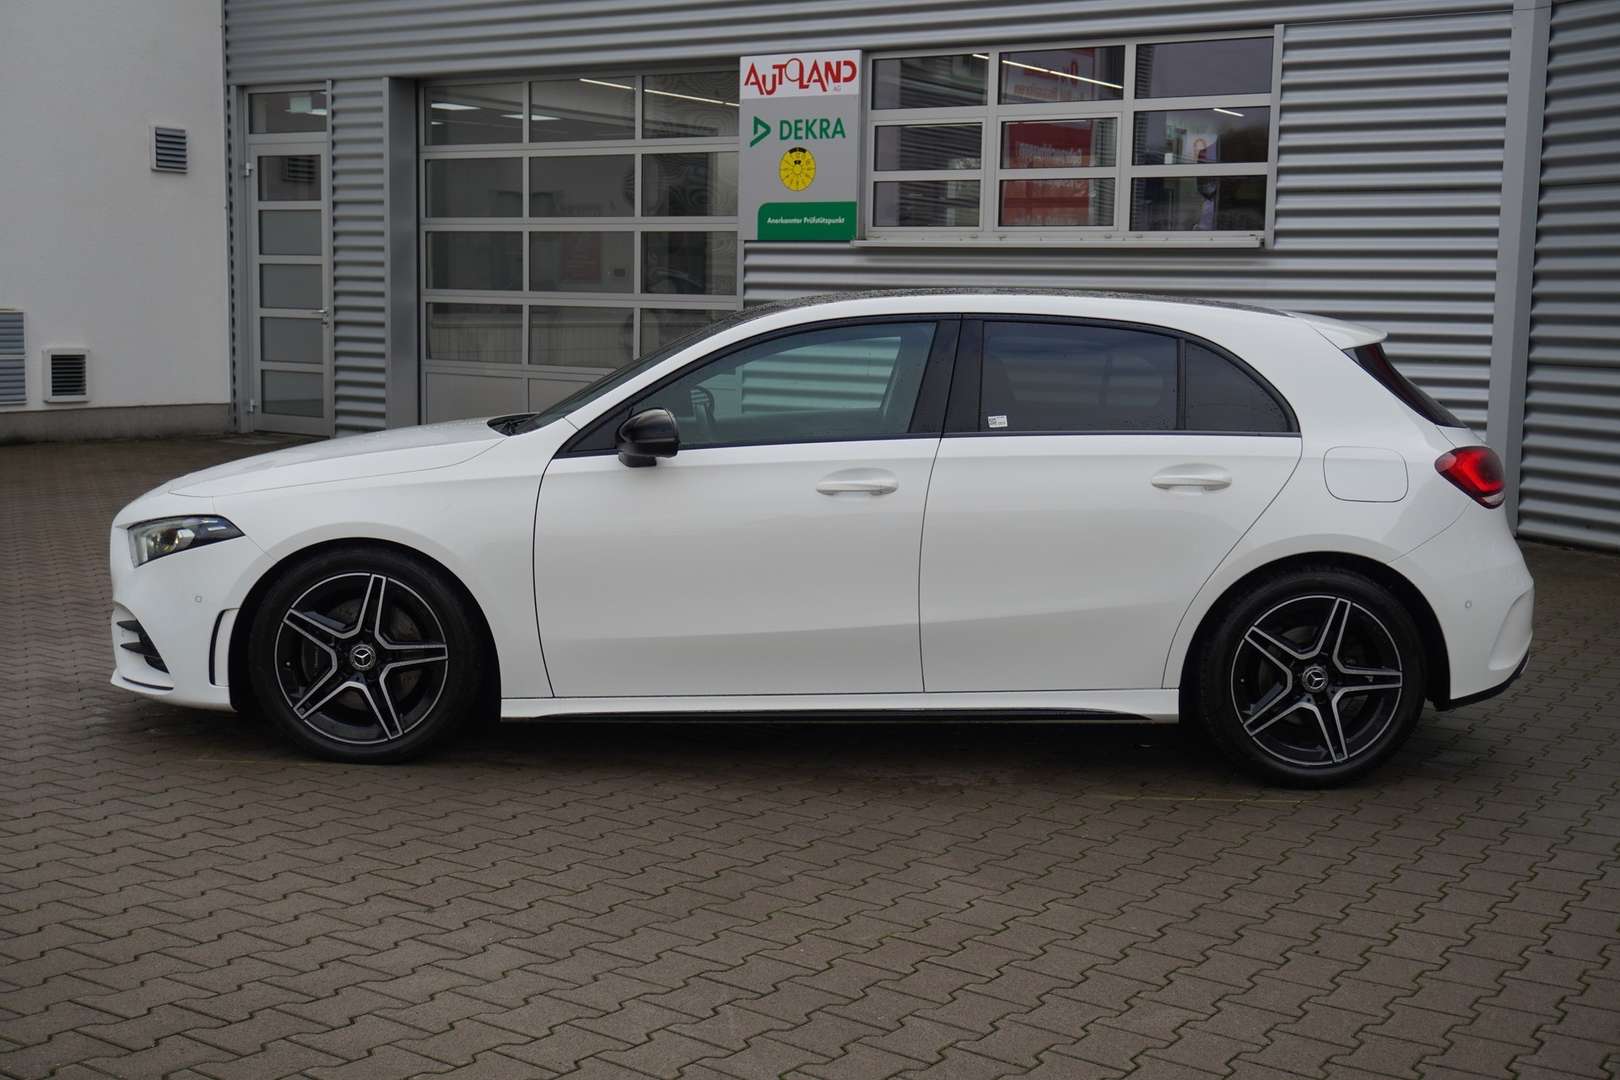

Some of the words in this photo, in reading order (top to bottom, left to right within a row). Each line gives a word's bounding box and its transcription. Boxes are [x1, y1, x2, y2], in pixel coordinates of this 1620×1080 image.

[744, 58, 857, 95] AUTOLAND
[779, 118, 846, 141] DEKRA
[767, 216, 802, 224] Anerkannter
[803, 216, 845, 226] Prüfstützpunkt
